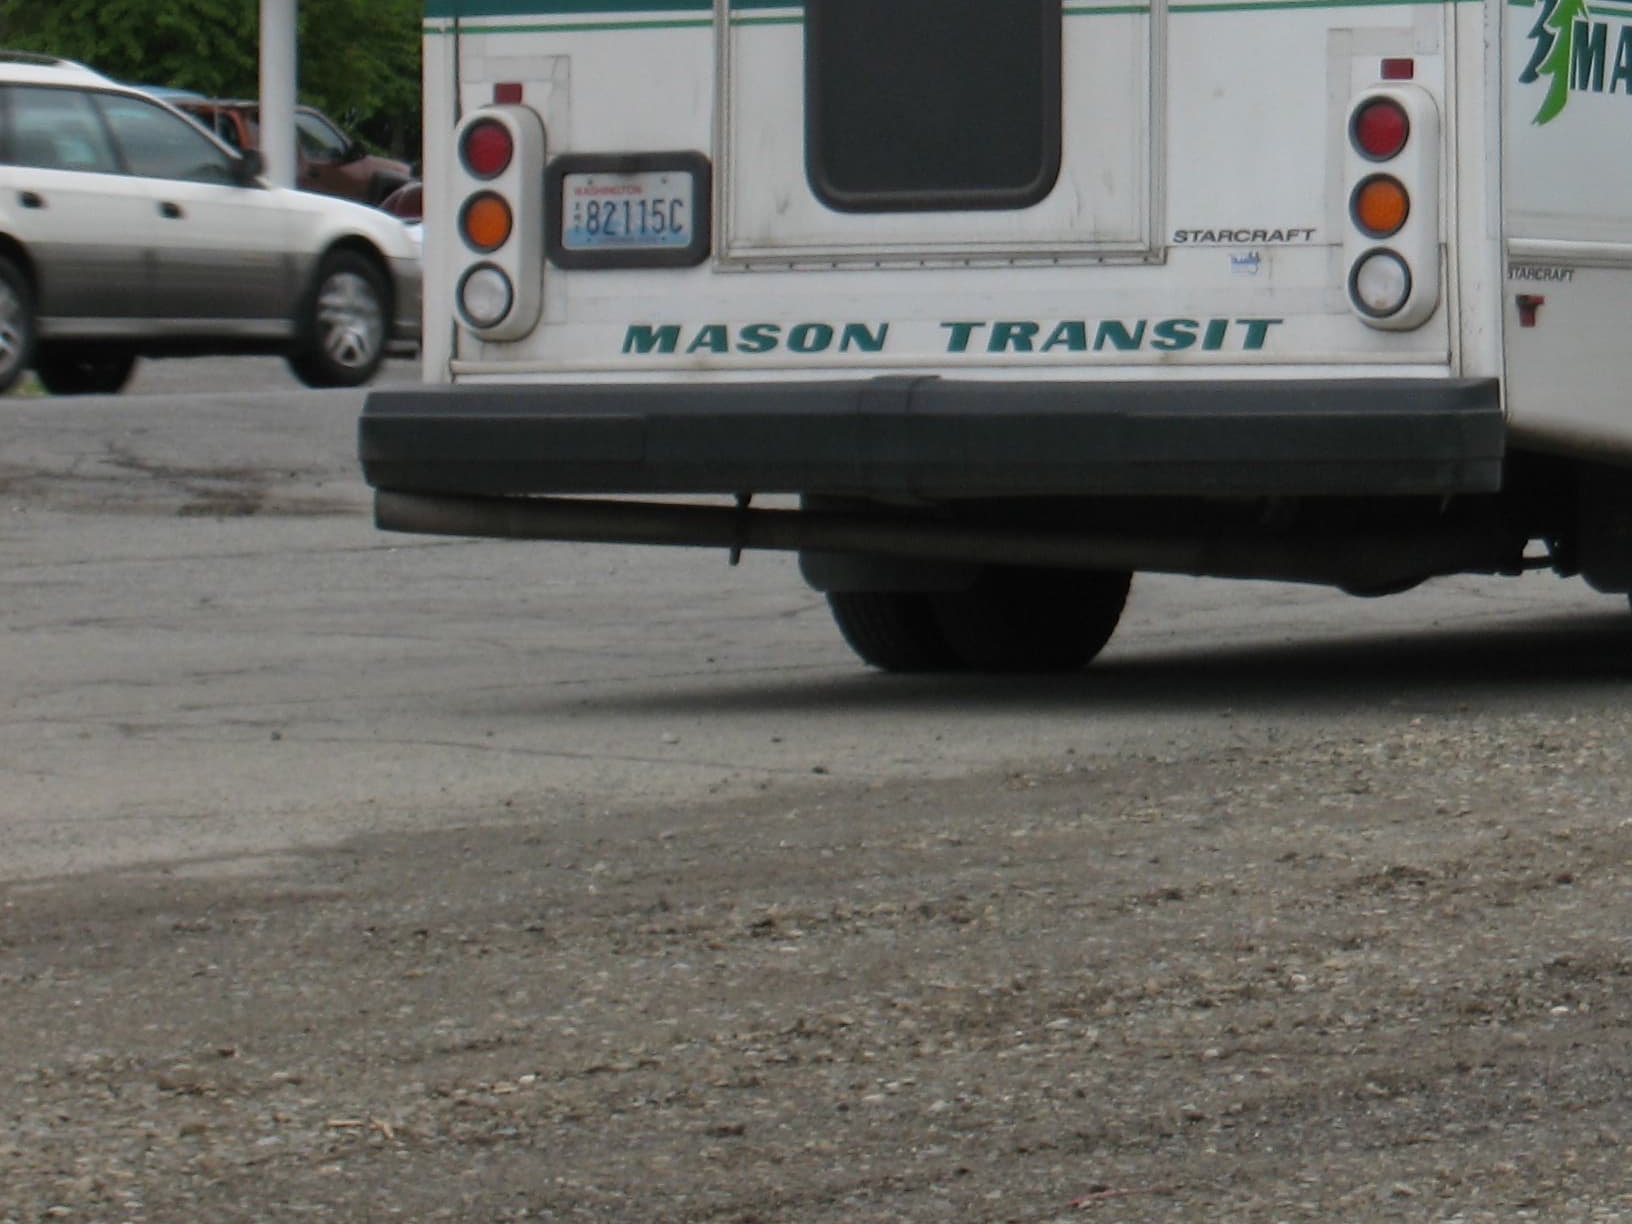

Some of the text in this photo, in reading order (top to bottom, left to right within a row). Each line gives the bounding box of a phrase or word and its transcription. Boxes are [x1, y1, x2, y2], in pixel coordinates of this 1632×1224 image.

[586, 198, 684, 236] 82115C
[1172, 228, 1316, 244] STARCRAFT
[621, 319, 1284, 355] MASON TRANSIT
